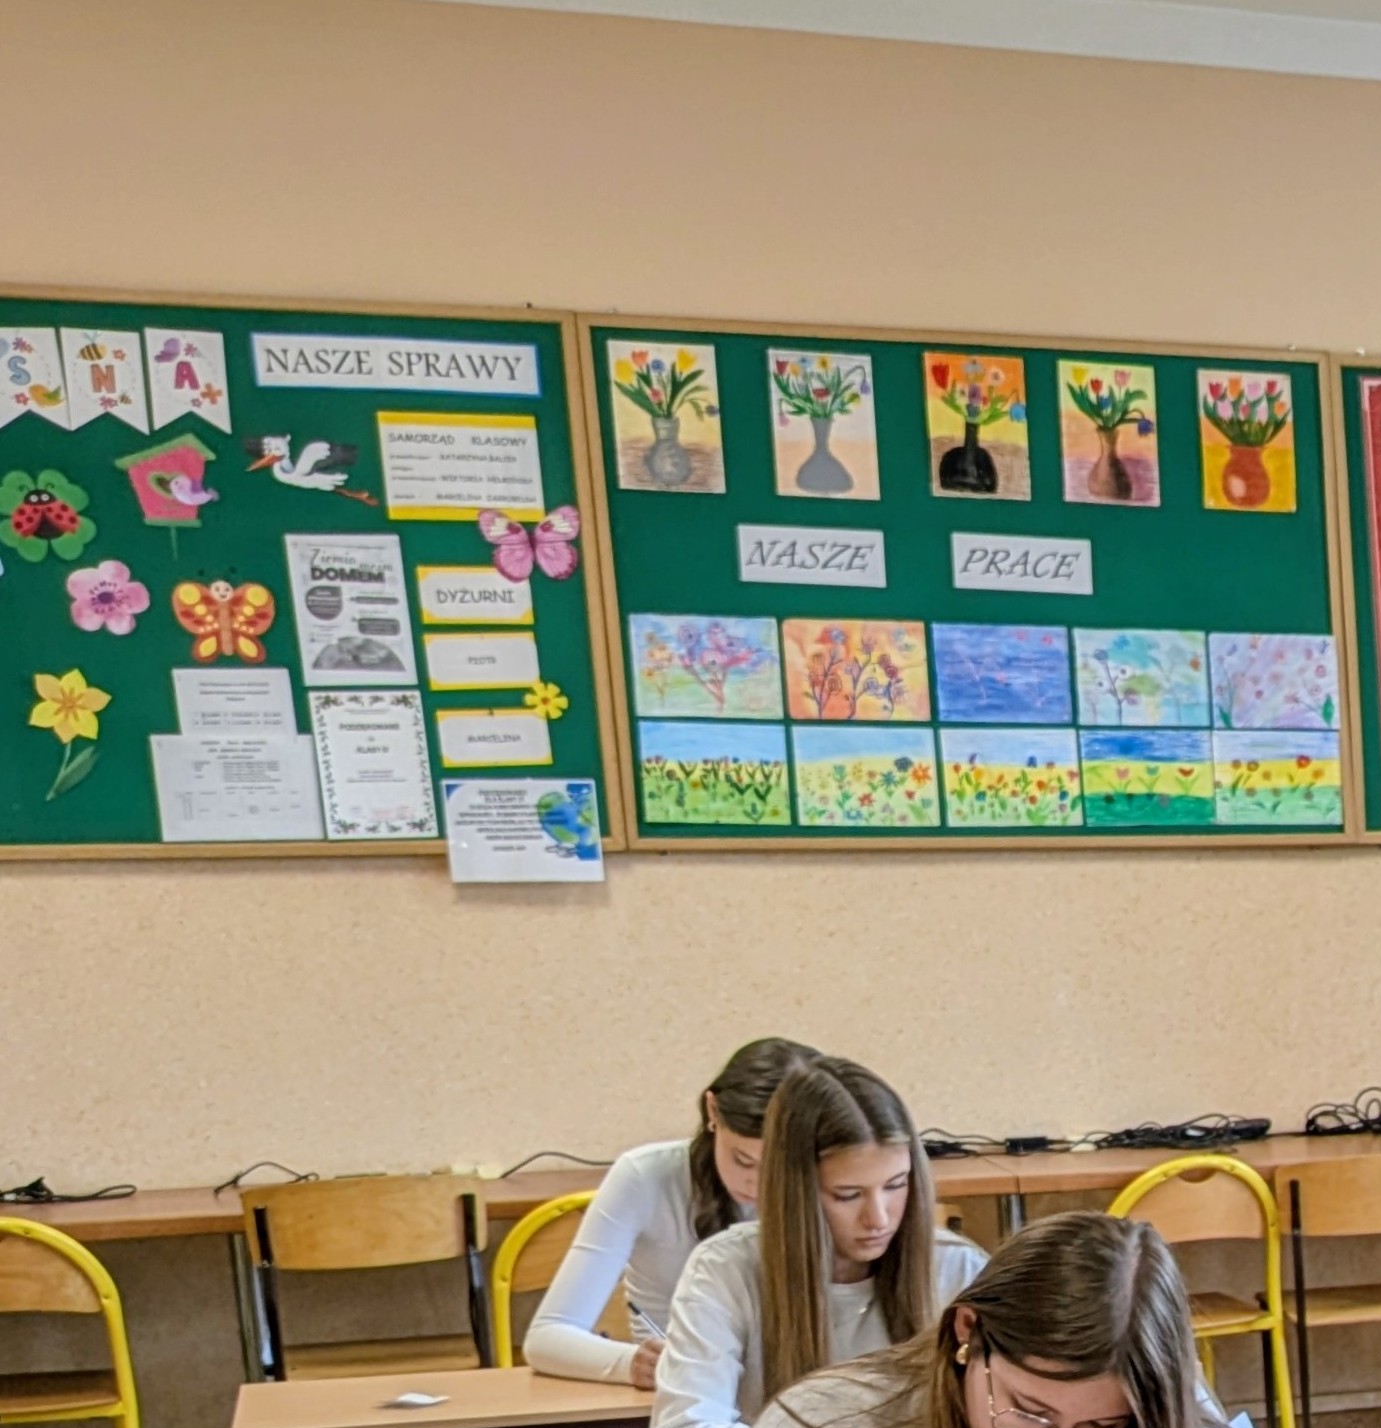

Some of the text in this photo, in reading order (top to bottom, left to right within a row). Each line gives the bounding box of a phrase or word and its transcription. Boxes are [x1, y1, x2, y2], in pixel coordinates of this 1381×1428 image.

[264, 348, 523, 381] NASZE SPRAWY
[388, 432, 528, 448] SAMORZĄD KLASOWY
[745, 539, 1082, 581] NASZE PRACE
[310, 567, 386, 584] DOMEM
[436, 587, 516, 604] DYŻURNI
